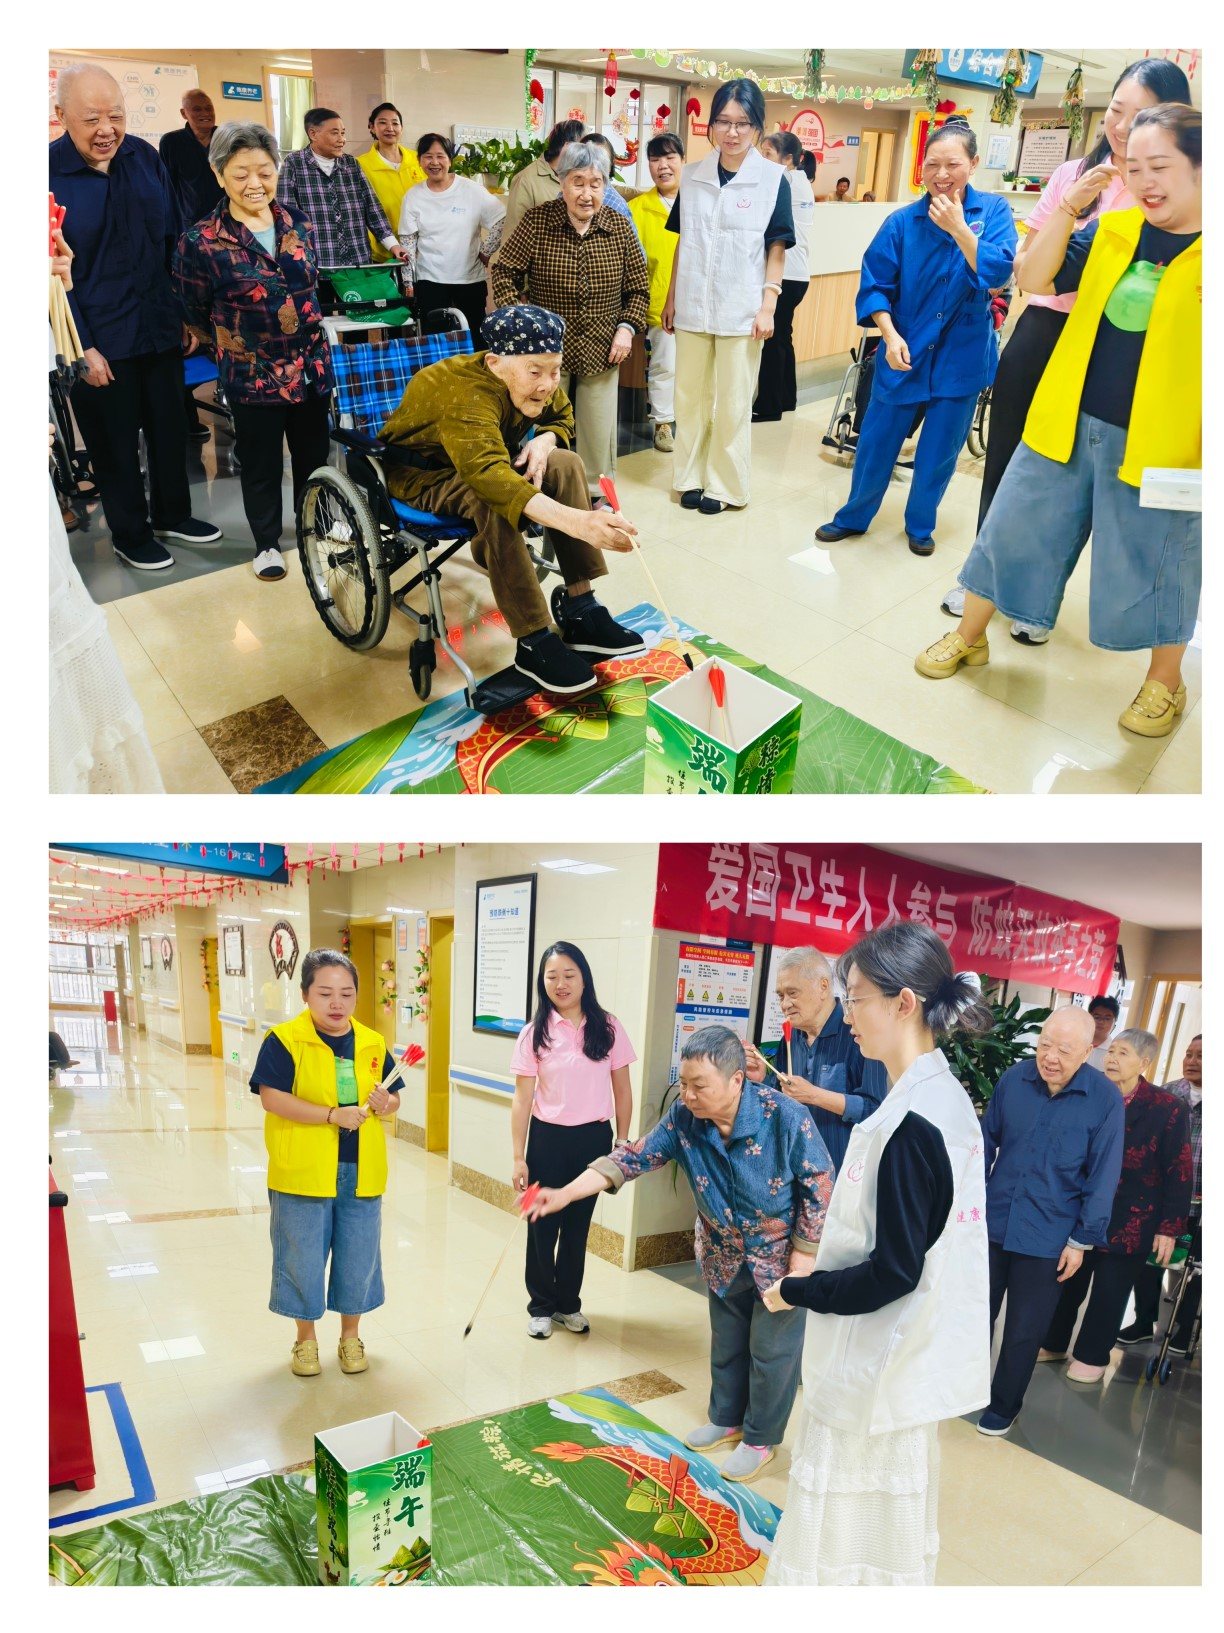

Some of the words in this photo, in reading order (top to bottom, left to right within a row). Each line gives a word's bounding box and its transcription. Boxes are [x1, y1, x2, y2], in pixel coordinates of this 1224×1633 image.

[687, 734, 727, 794] 端
[705, 843, 958, 949] 爱国卫生人人参与
[390, 1455, 426, 1527] 端午
